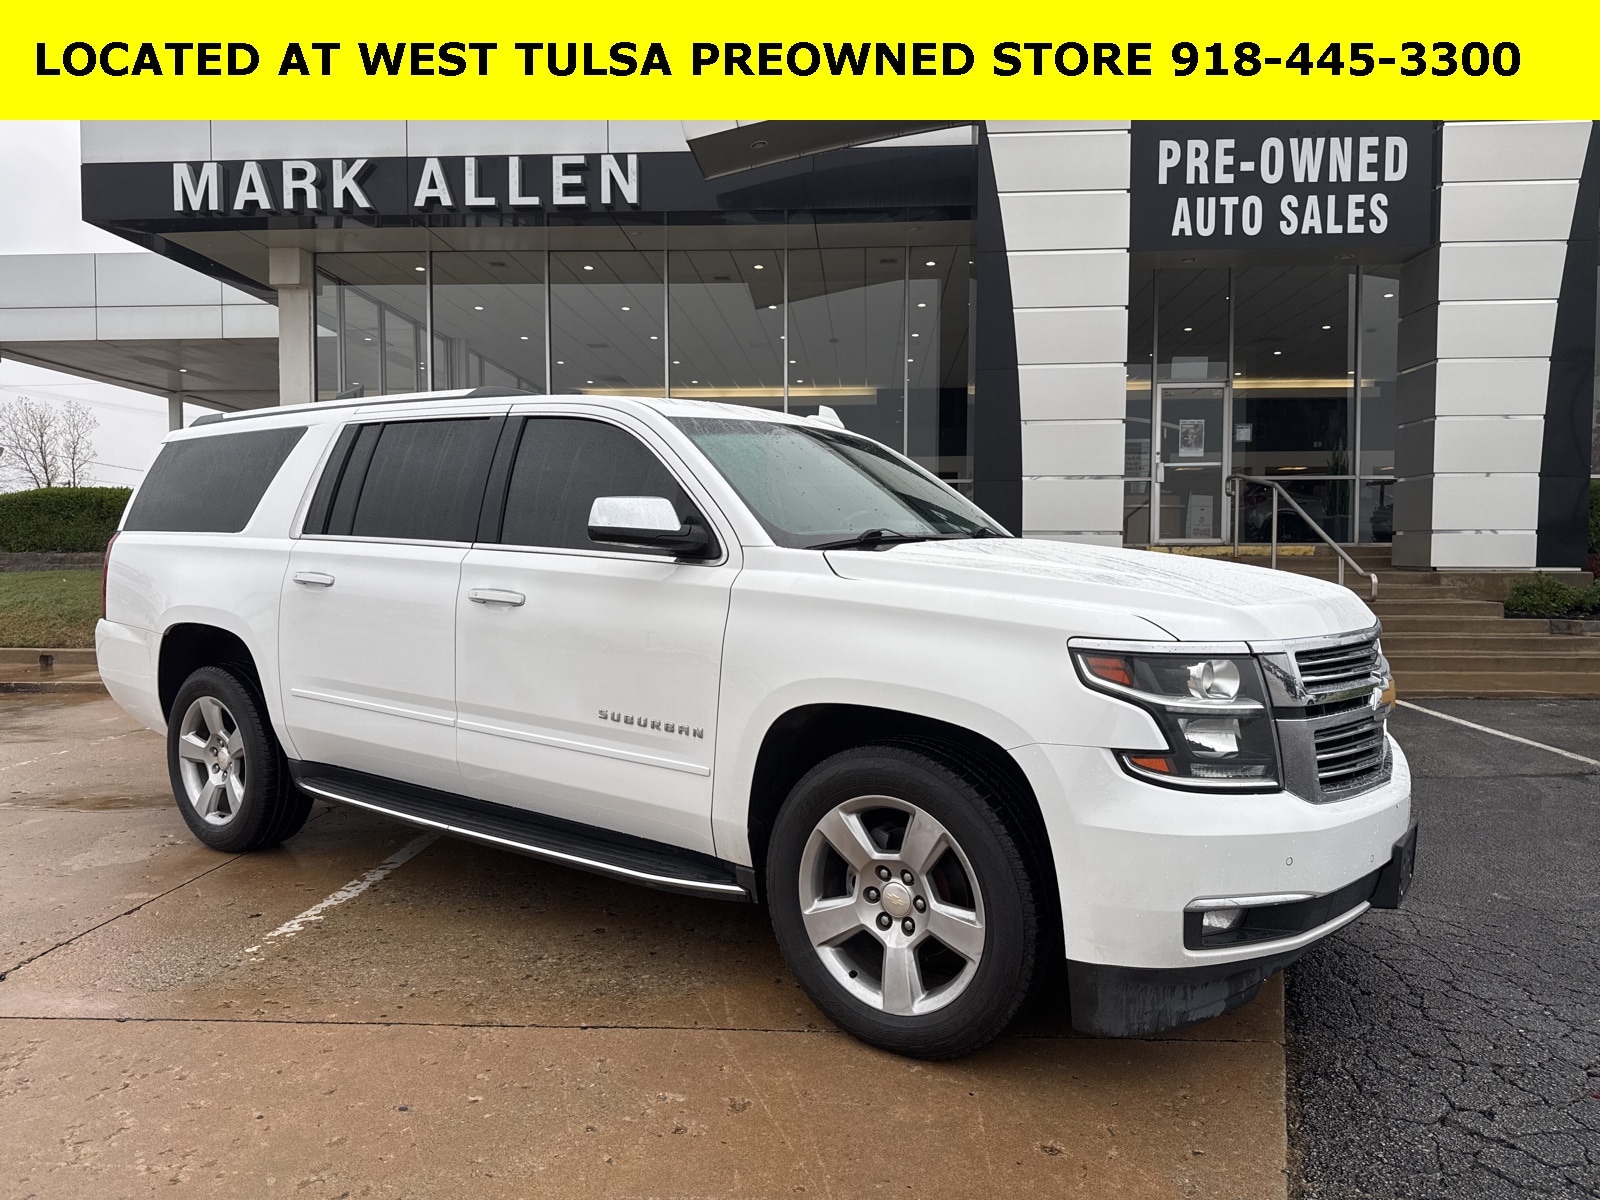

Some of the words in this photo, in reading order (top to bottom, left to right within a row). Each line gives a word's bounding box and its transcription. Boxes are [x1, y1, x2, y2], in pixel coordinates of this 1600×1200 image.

[1158, 136, 1408, 184] PRE-OWNED
[172, 158, 374, 213] MARK
[413, 153, 641, 208] ALLEN
[1171, 195, 1263, 236] AUTO
[1279, 193, 1389, 235] SALES
[597, 709, 704, 739] SUBURBAN
